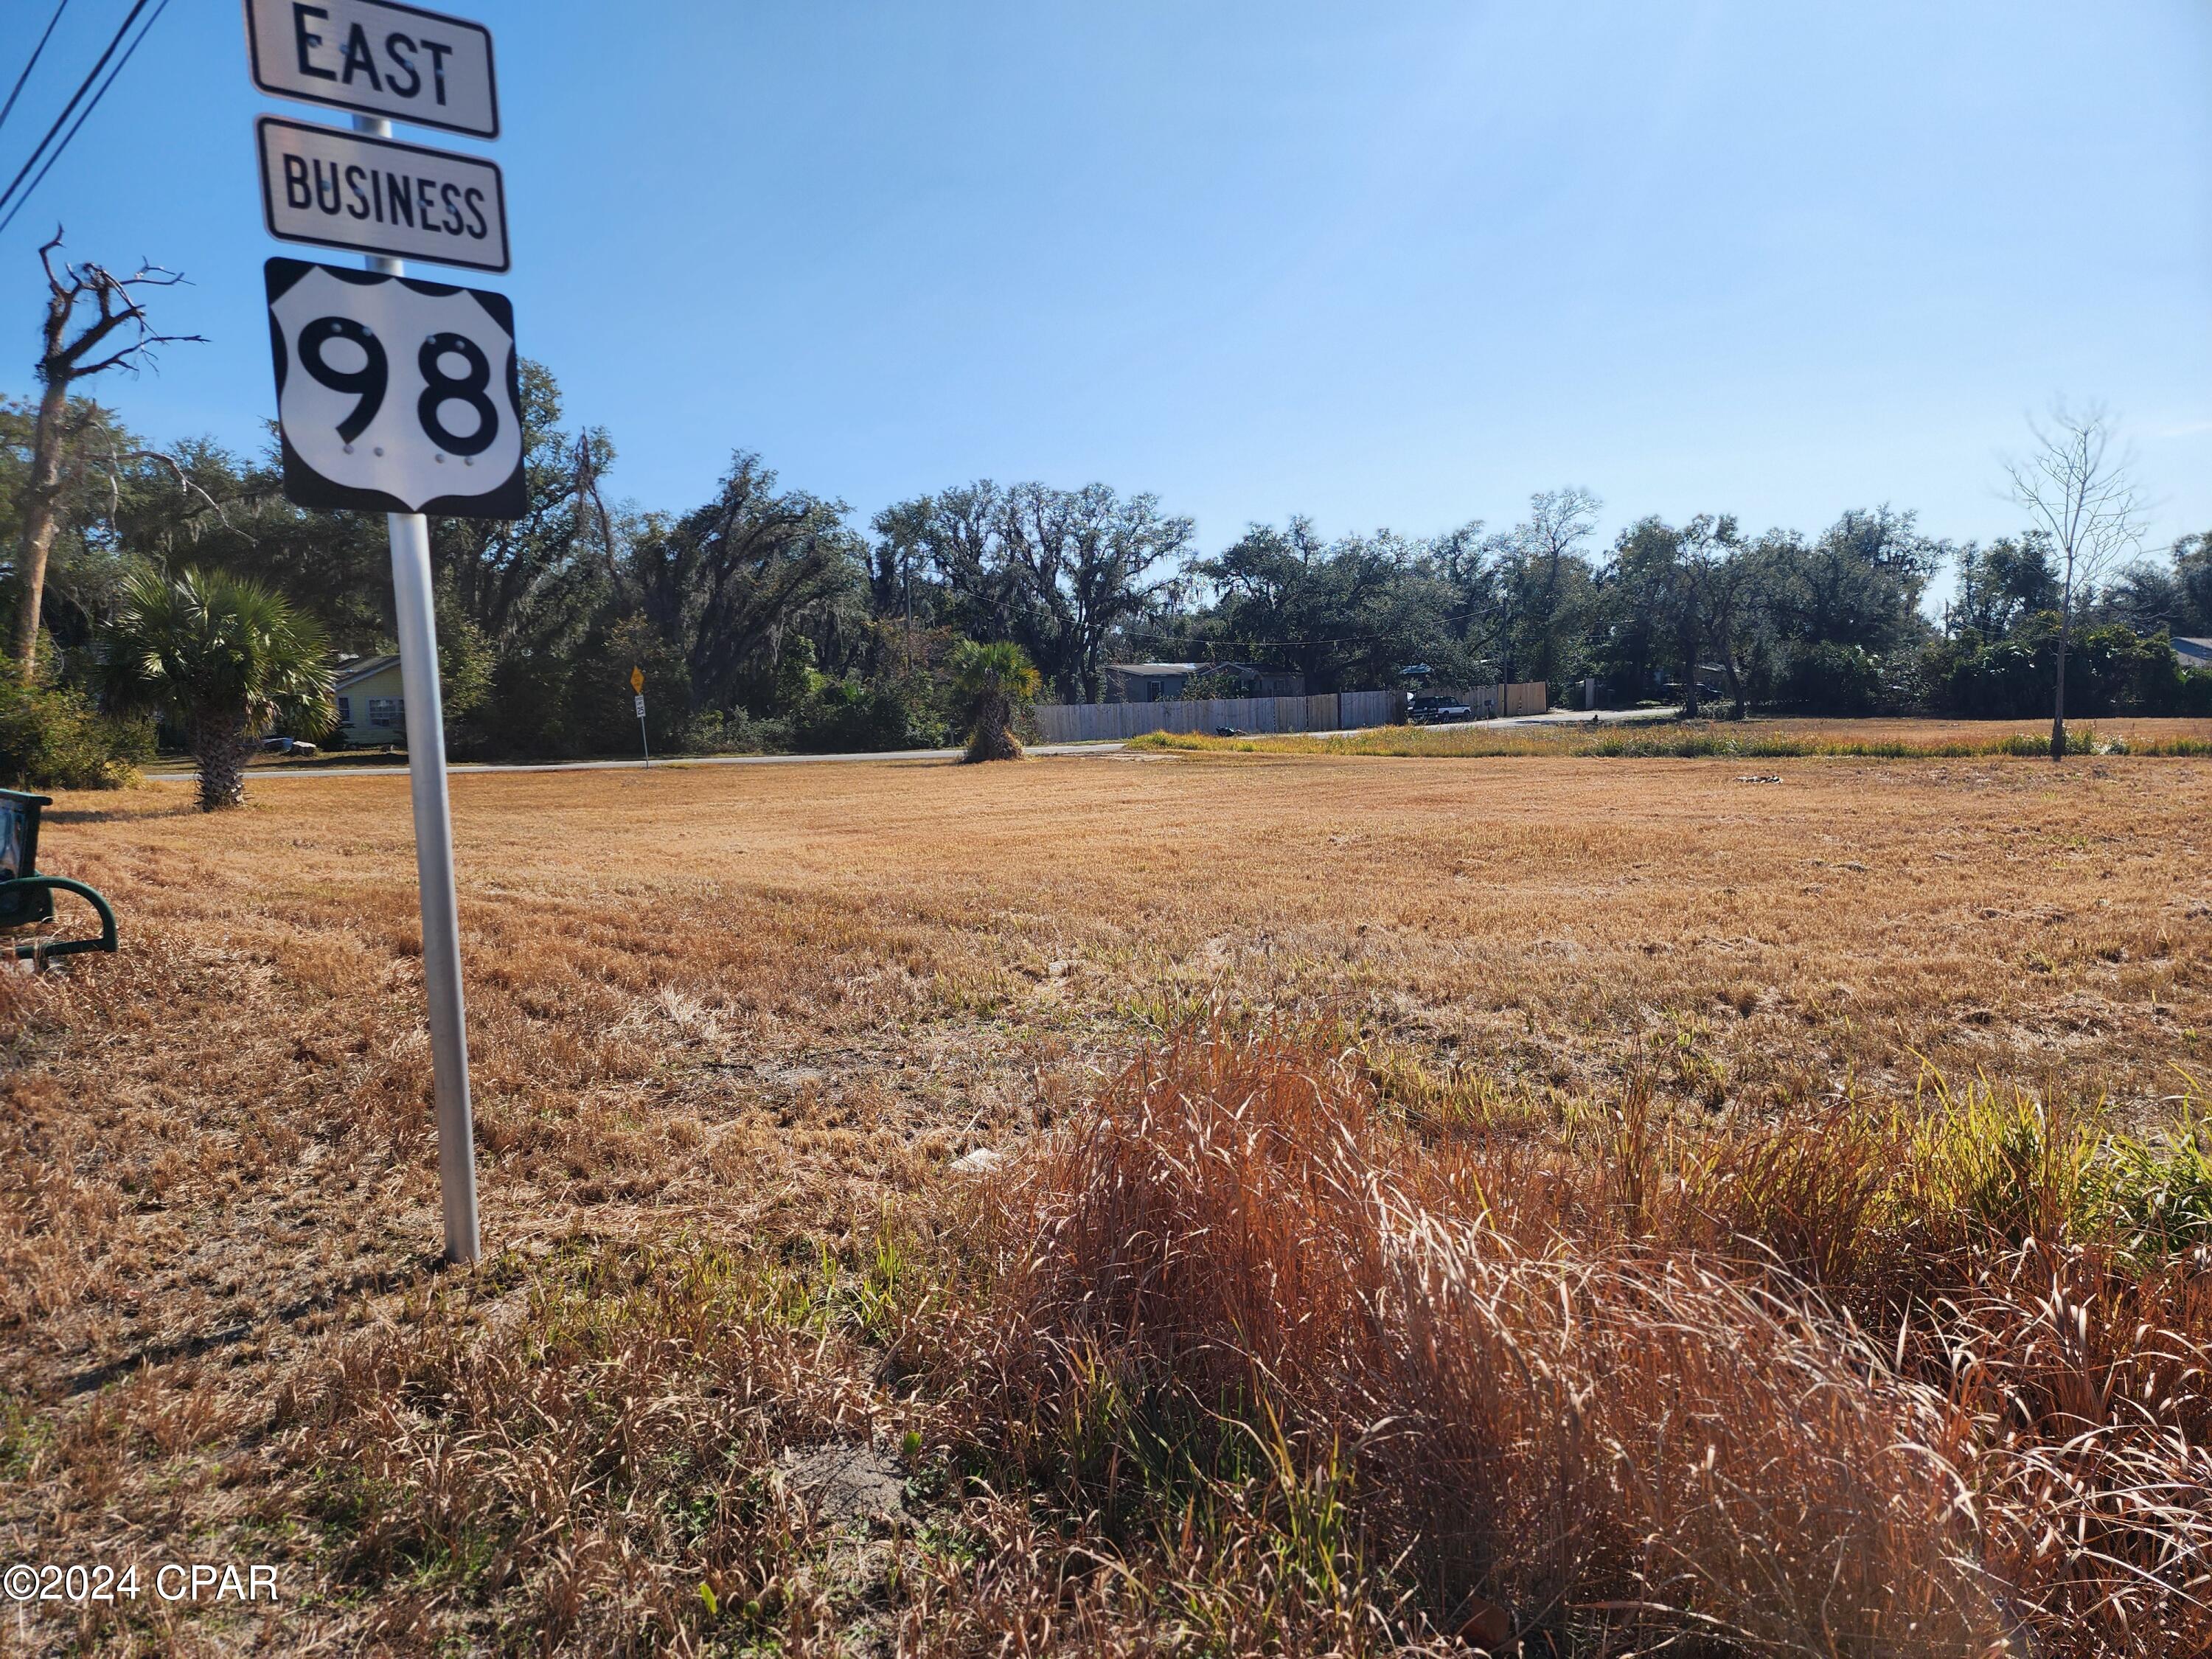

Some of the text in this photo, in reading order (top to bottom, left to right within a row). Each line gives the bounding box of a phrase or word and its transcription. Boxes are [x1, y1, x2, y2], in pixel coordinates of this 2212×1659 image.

[293, 1, 453, 106] EAST
[282, 153, 488, 240] BUSINESS
[297, 316, 499, 456] 98
